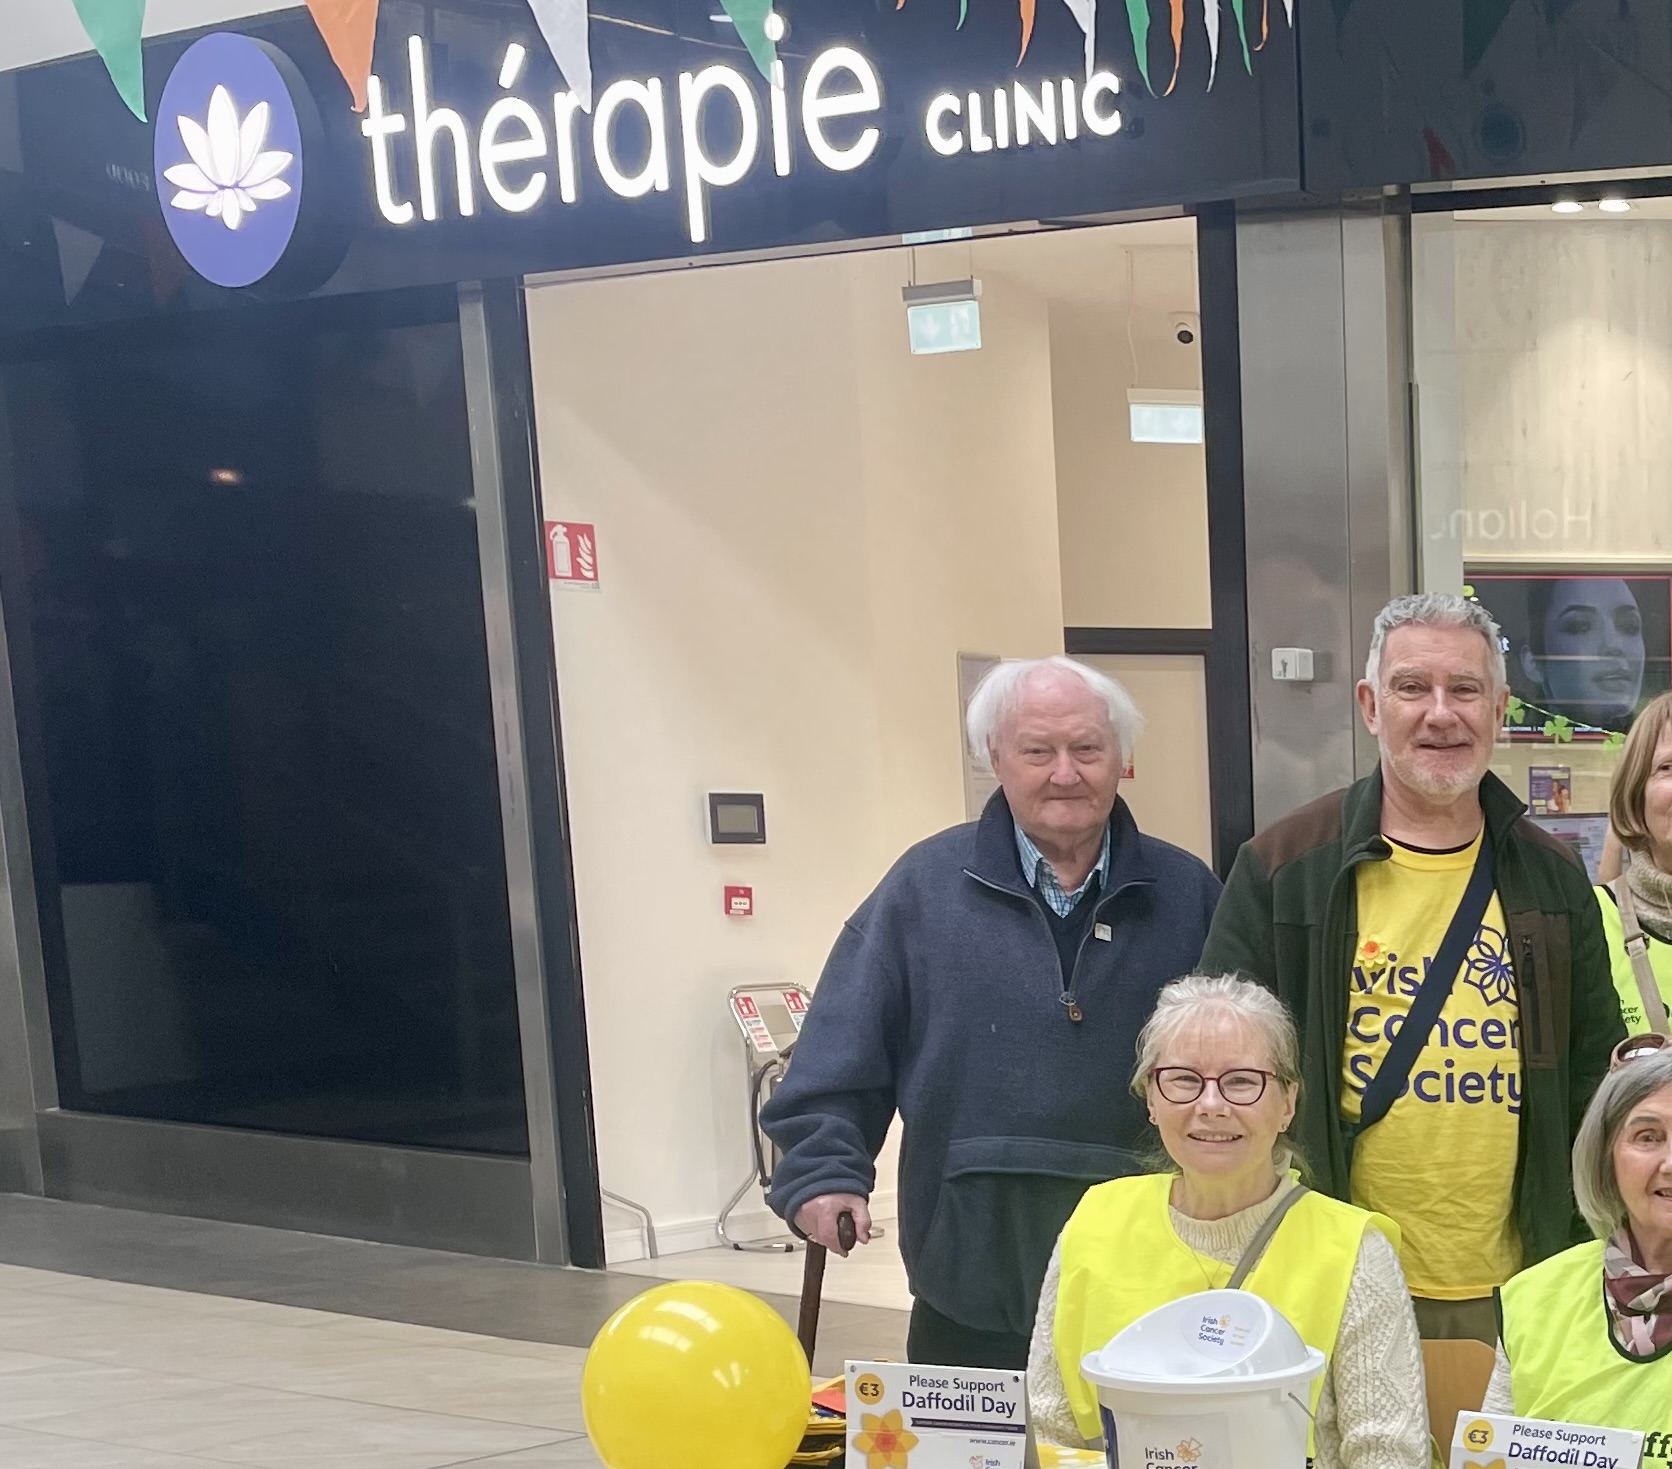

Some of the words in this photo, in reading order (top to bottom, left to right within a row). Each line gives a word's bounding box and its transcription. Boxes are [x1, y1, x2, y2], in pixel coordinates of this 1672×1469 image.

[361, 12, 882, 242] thérapie
[925, 71, 1122, 158] CLINIC
[1350, 1055, 1520, 1114] Sciety
[1202, 1315, 1218, 1326] Irish
[1198, 1332, 1224, 1345] Society
[1200, 1324, 1226, 1336] Cancer
[859, 1382, 879, 1397] €3
[909, 1374, 948, 1389] Please
[953, 1377, 1005, 1394] Support
[902, 1391, 975, 1412] Daffodil
[982, 1396, 1016, 1419] Day
[1467, 1429, 1489, 1444] €3
[1512, 1424, 1552, 1440] Please
[1555, 1430, 1606, 1446] Support
[1145, 1446, 1174, 1461] Irish
[1508, 1442, 1578, 1465] Daffodil
